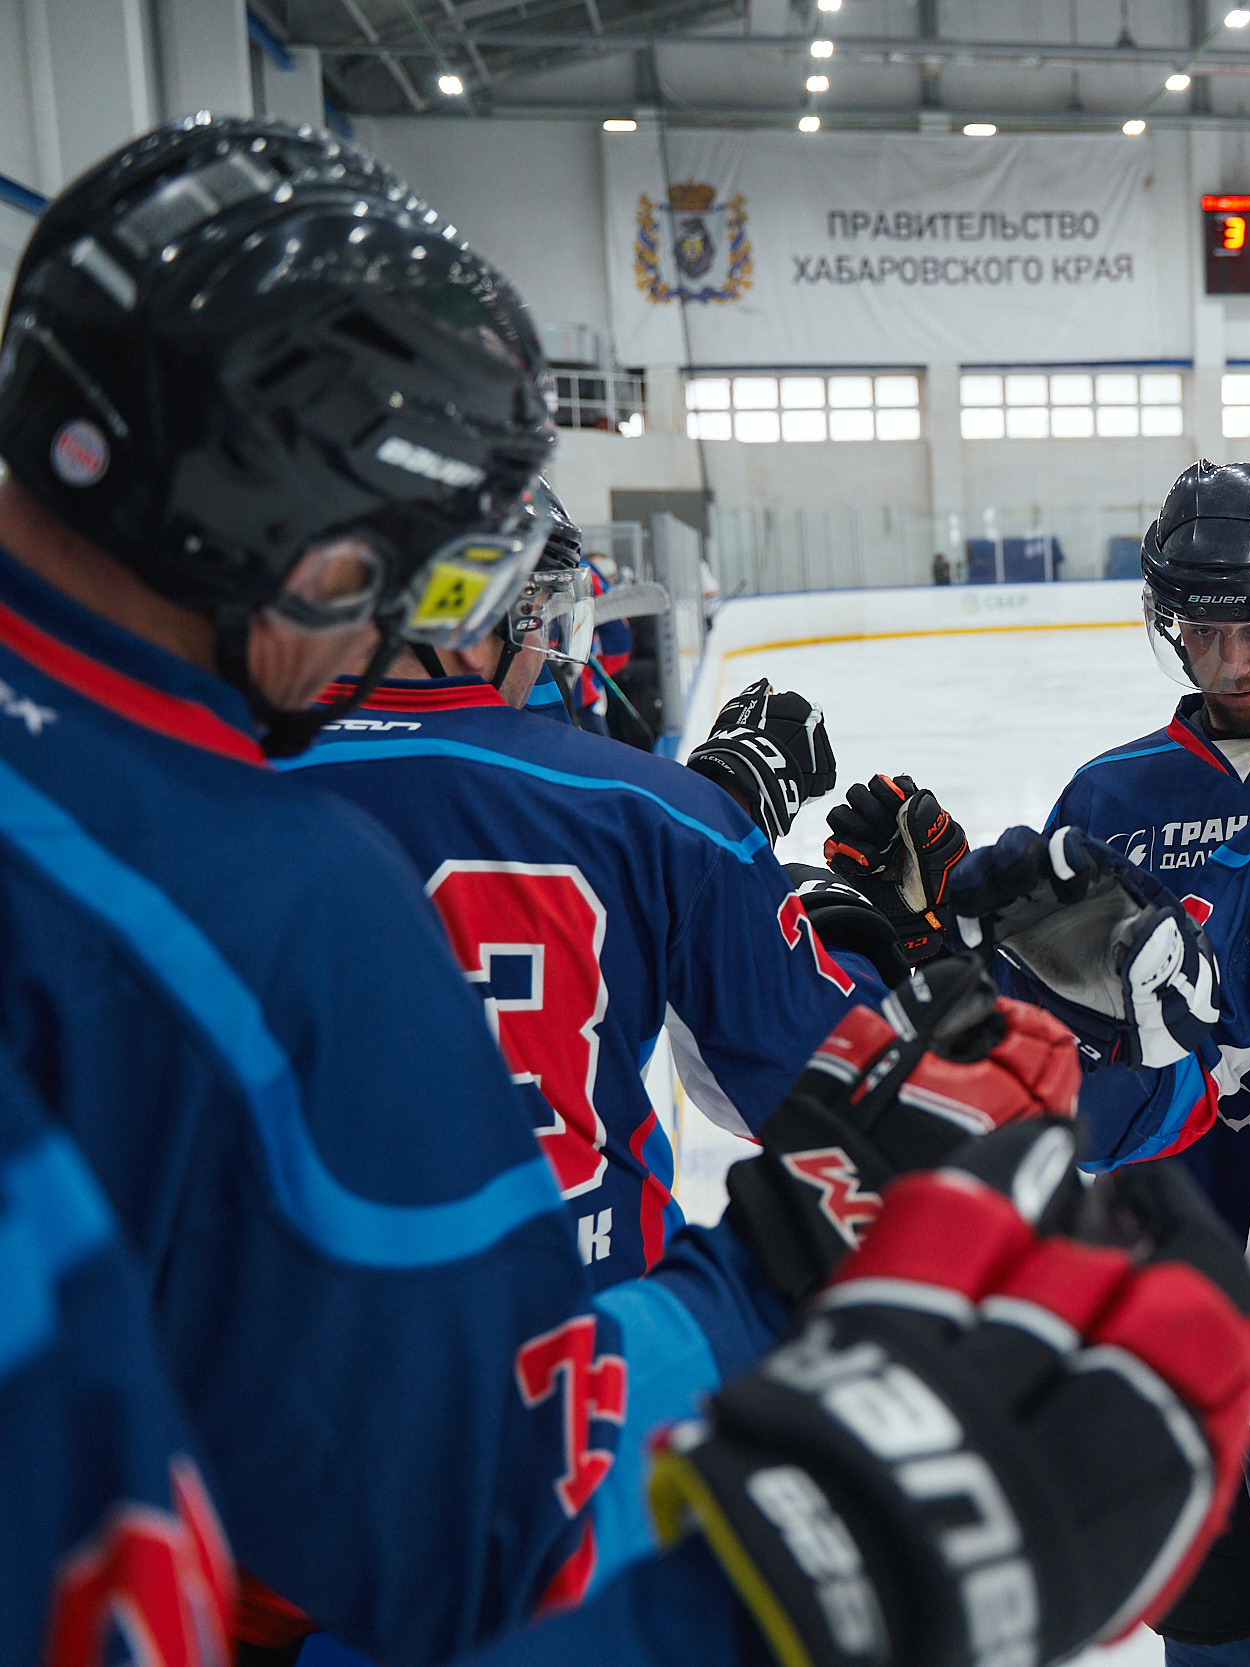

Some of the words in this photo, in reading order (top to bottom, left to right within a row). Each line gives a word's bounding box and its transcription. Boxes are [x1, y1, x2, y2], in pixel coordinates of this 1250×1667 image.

[827, 210, 1100, 241] ПРАВИТЕЛЬСТВО
[1222, 216, 1245, 250] 3
[792, 254, 1045, 286] ХАБАРОВСКОГО
[1052, 253, 1134, 284] КРАЯ
[1187, 594, 1247, 604] BAUER
